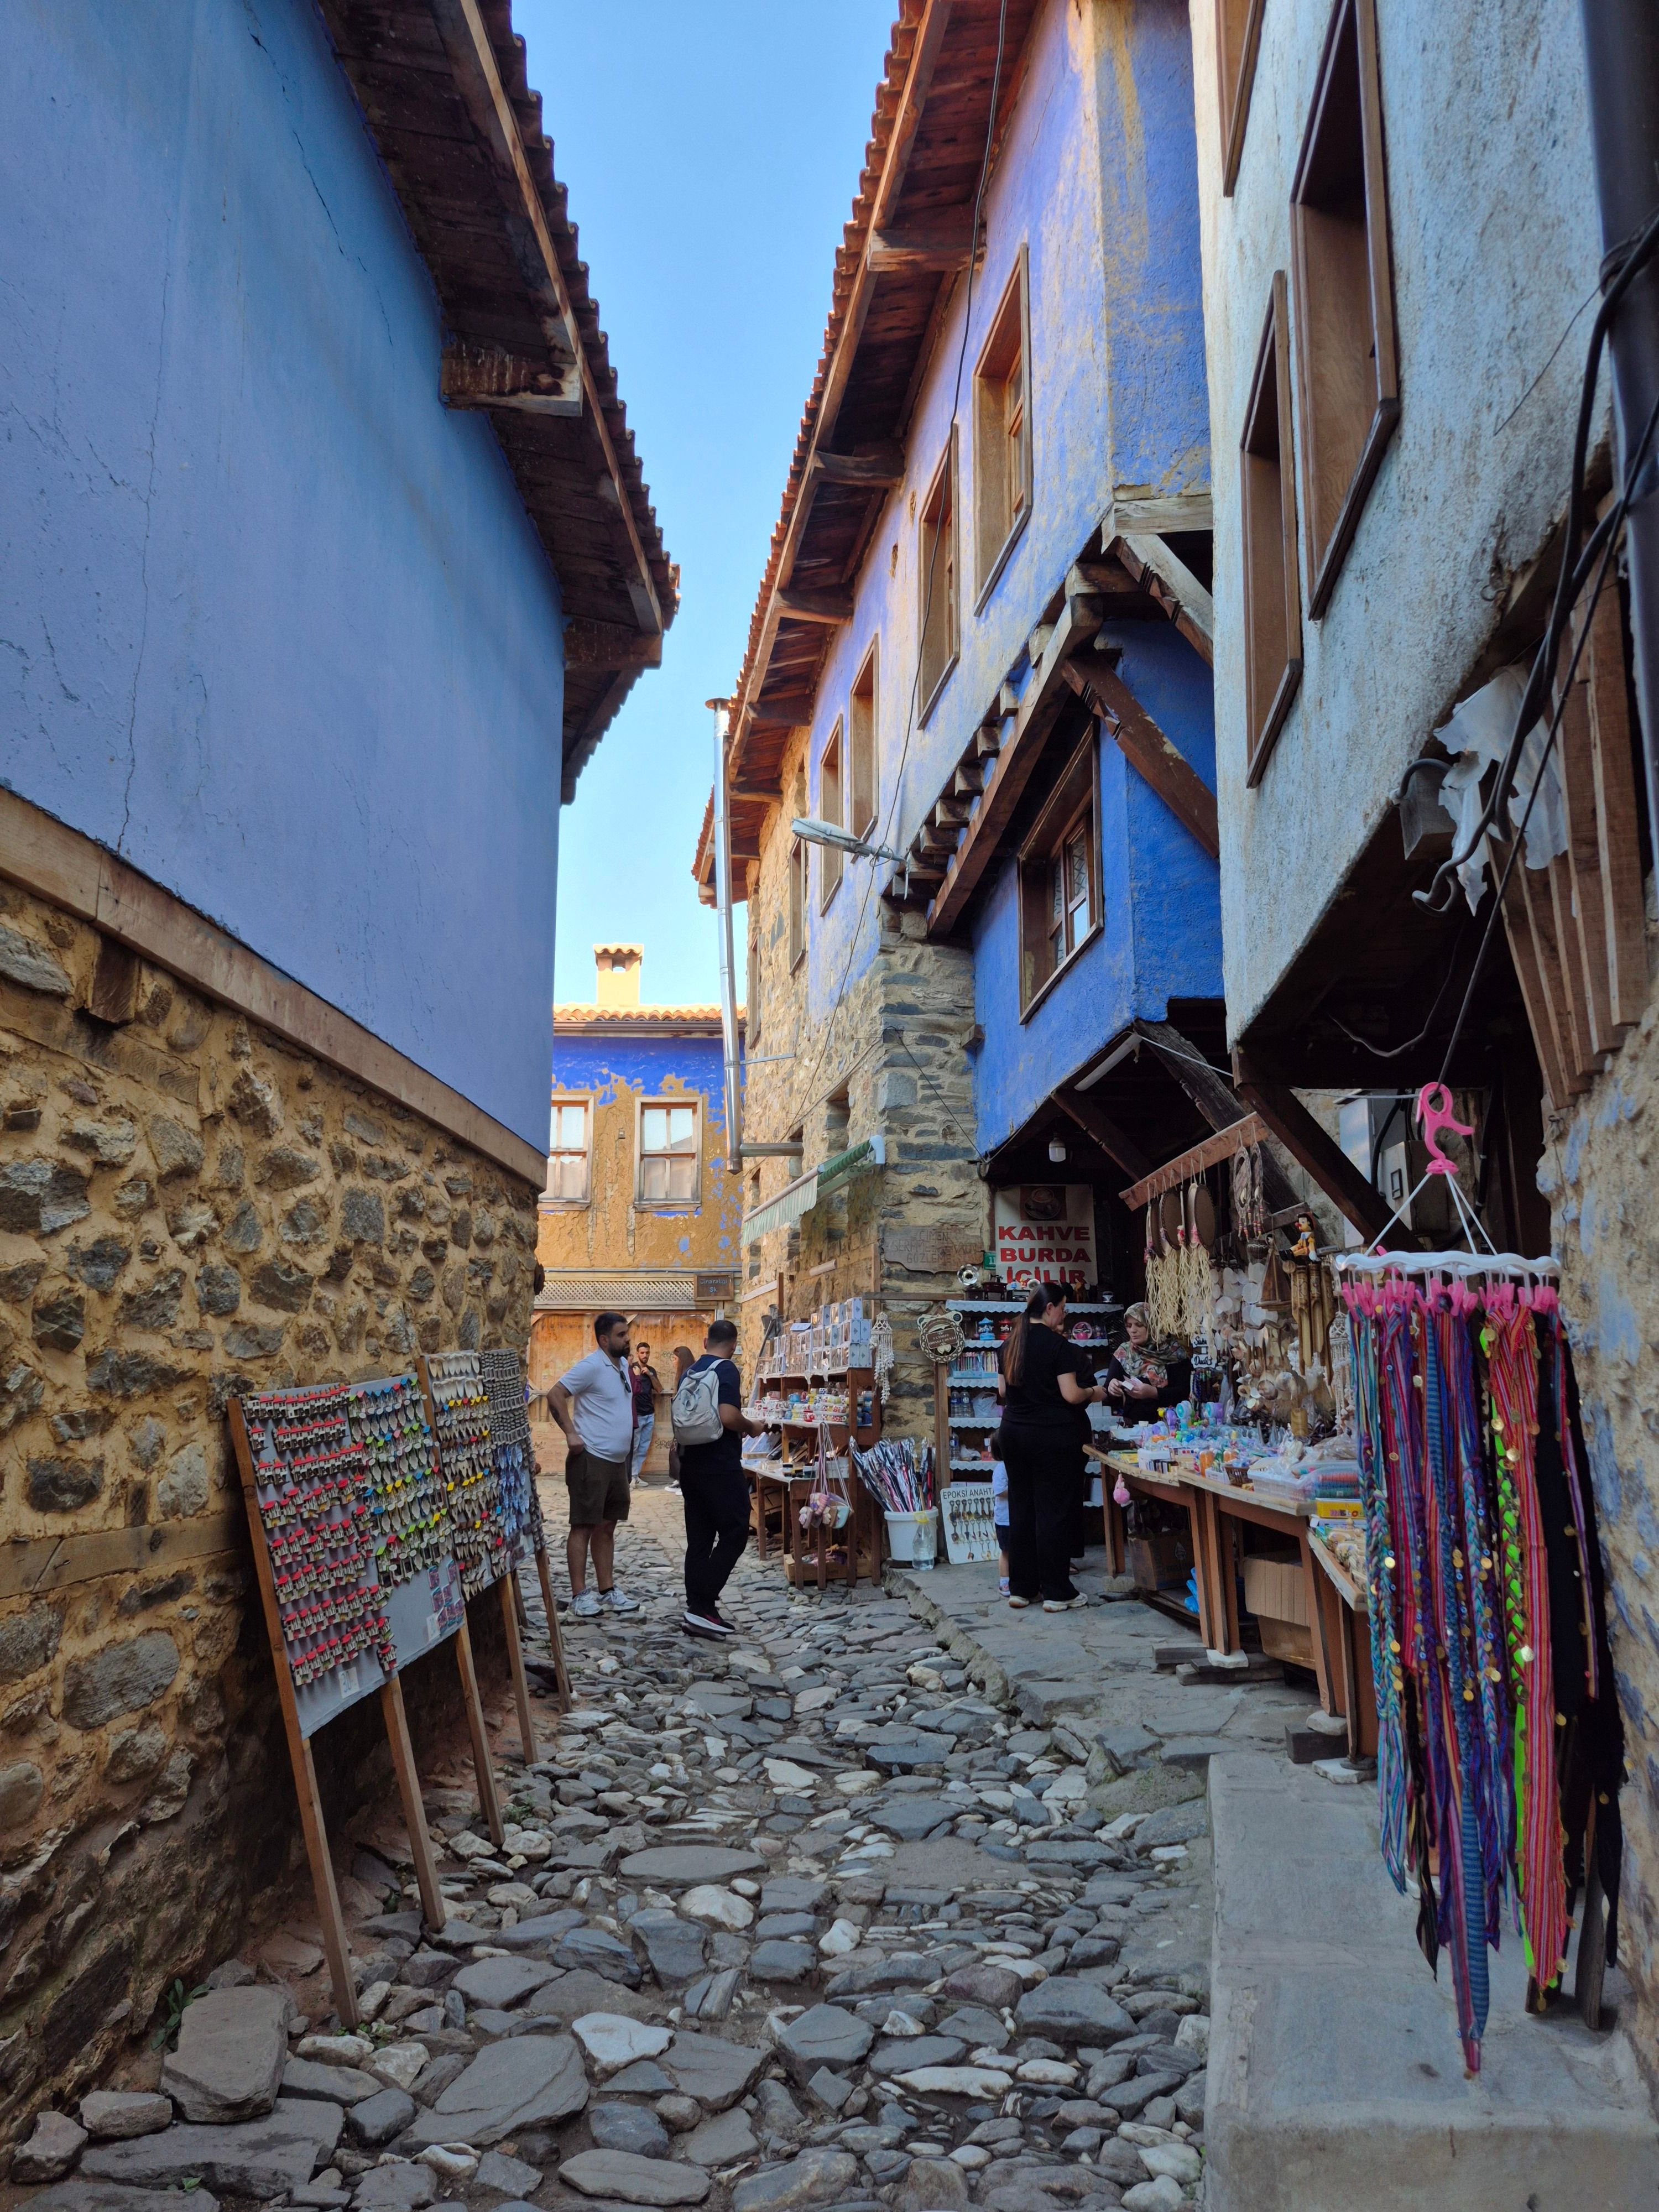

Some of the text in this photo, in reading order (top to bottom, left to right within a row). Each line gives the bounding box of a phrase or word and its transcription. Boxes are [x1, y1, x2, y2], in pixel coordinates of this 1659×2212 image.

[999, 1226, 1090, 1240] KAHVE
[1000, 1248, 1091, 1262] BURDA
[943, 1488, 994, 1499] EPOKSİ ANAHT
